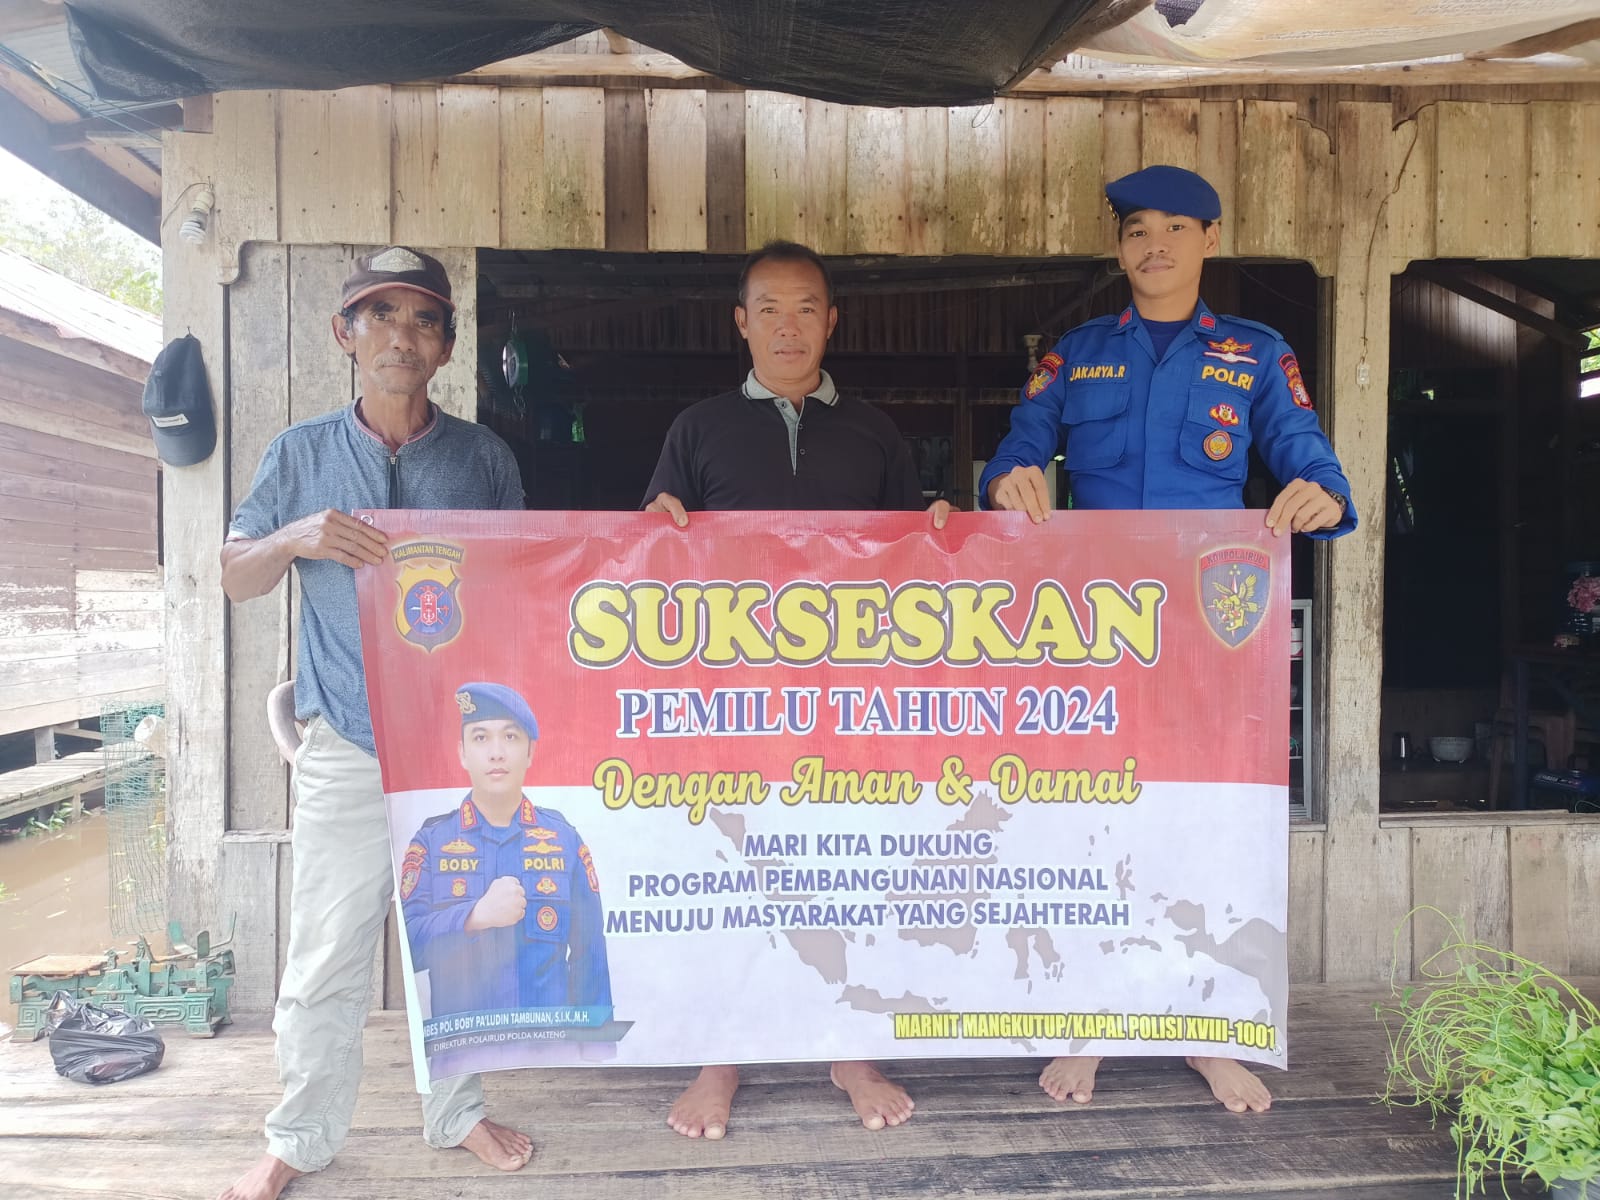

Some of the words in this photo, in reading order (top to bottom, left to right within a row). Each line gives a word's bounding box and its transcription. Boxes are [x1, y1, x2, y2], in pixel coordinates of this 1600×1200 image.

[1069, 365, 1126, 382] JAKARYA.R
[1201, 365, 1255, 391] POLRI
[394, 545, 434, 560] KALIMANTAN
[435, 546, 461, 560] TENGAH
[569, 580, 1166, 668] SUKSESKAN
[617, 688, 821, 736] PEMILU
[831, 688, 1006, 735] TAHUN
[1015, 687, 1117, 734] 2024
[593, 757, 770, 825] Dengan
[780, 755, 923, 806] Aman
[936, 755, 975, 806] &
[989, 753, 1142, 805] Damai
[744, 834, 807, 857] MARI
[816, 834, 872, 857] KITA
[880, 833, 993, 857] DUKUNG
[438, 858, 479, 872] BOBY
[524, 858, 566, 872] POLRI
[629, 869, 757, 897] PROGRAM
[765, 868, 967, 892] PEMBANGUNAN
[976, 867, 1109, 891] NASIONAL
[606, 907, 714, 934] MENUJU
[722, 903, 887, 929] MASYARAKAT
[894, 902, 966, 926] YANG
[973, 902, 1130, 926] SEJAHTERAH
[439, 1019, 454, 1034] POL
[454, 1016, 475, 1031] BOBY
[475, 1013, 509, 1028] PA'LUDIN
[895, 1012, 960, 1040] MARNIT
[961, 1012, 1125, 1041] MANGKUTUP/KAPAL
[1127, 1014, 1184, 1041] POLISI
[1185, 1014, 1276, 1052] XVIII-1001
[434, 1039, 468, 1052] DIREKTUR
[468, 1033, 506, 1046] POLAIRUD
[507, 1031, 532, 1041] POLDA
[533, 1030, 567, 1040] KALTENG
